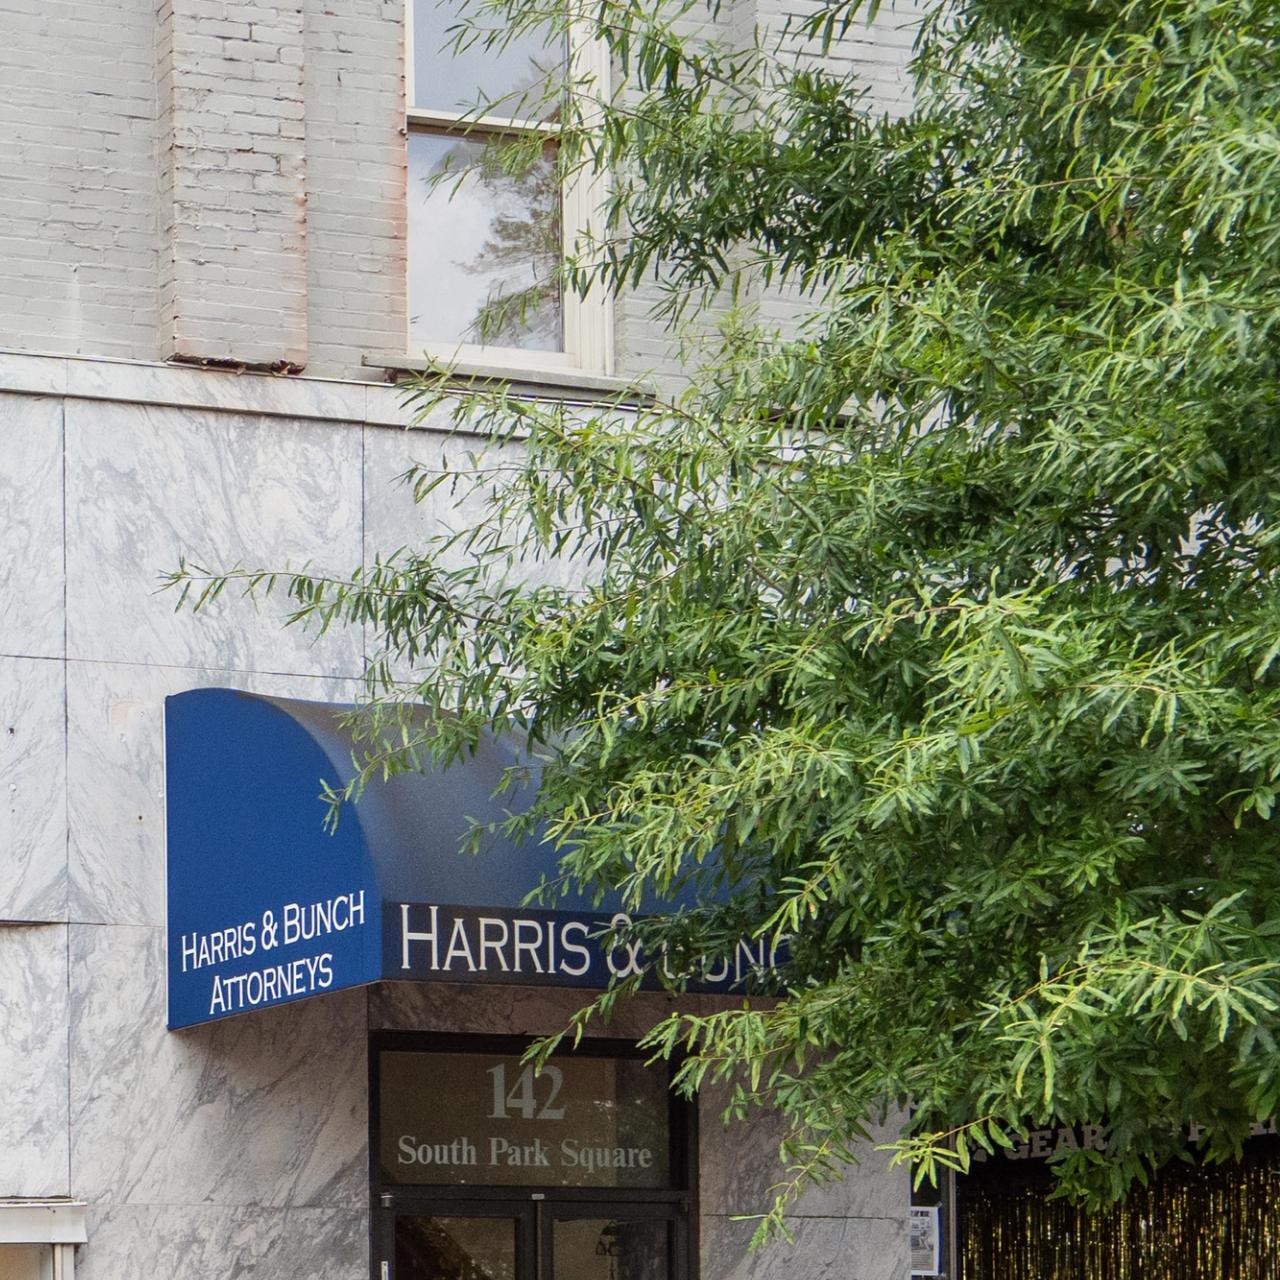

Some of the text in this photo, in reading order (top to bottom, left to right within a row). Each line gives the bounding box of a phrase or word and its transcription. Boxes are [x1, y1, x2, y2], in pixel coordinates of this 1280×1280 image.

[181, 889, 366, 972] HARRIS & BUNCH
[400, 904, 590, 974] HARRIS
[607, 913, 643, 977] &
[209, 953, 334, 1015] ATTORNEYS
[486, 1063, 565, 1120] 142
[396, 1134, 653, 1169] South Park Square
